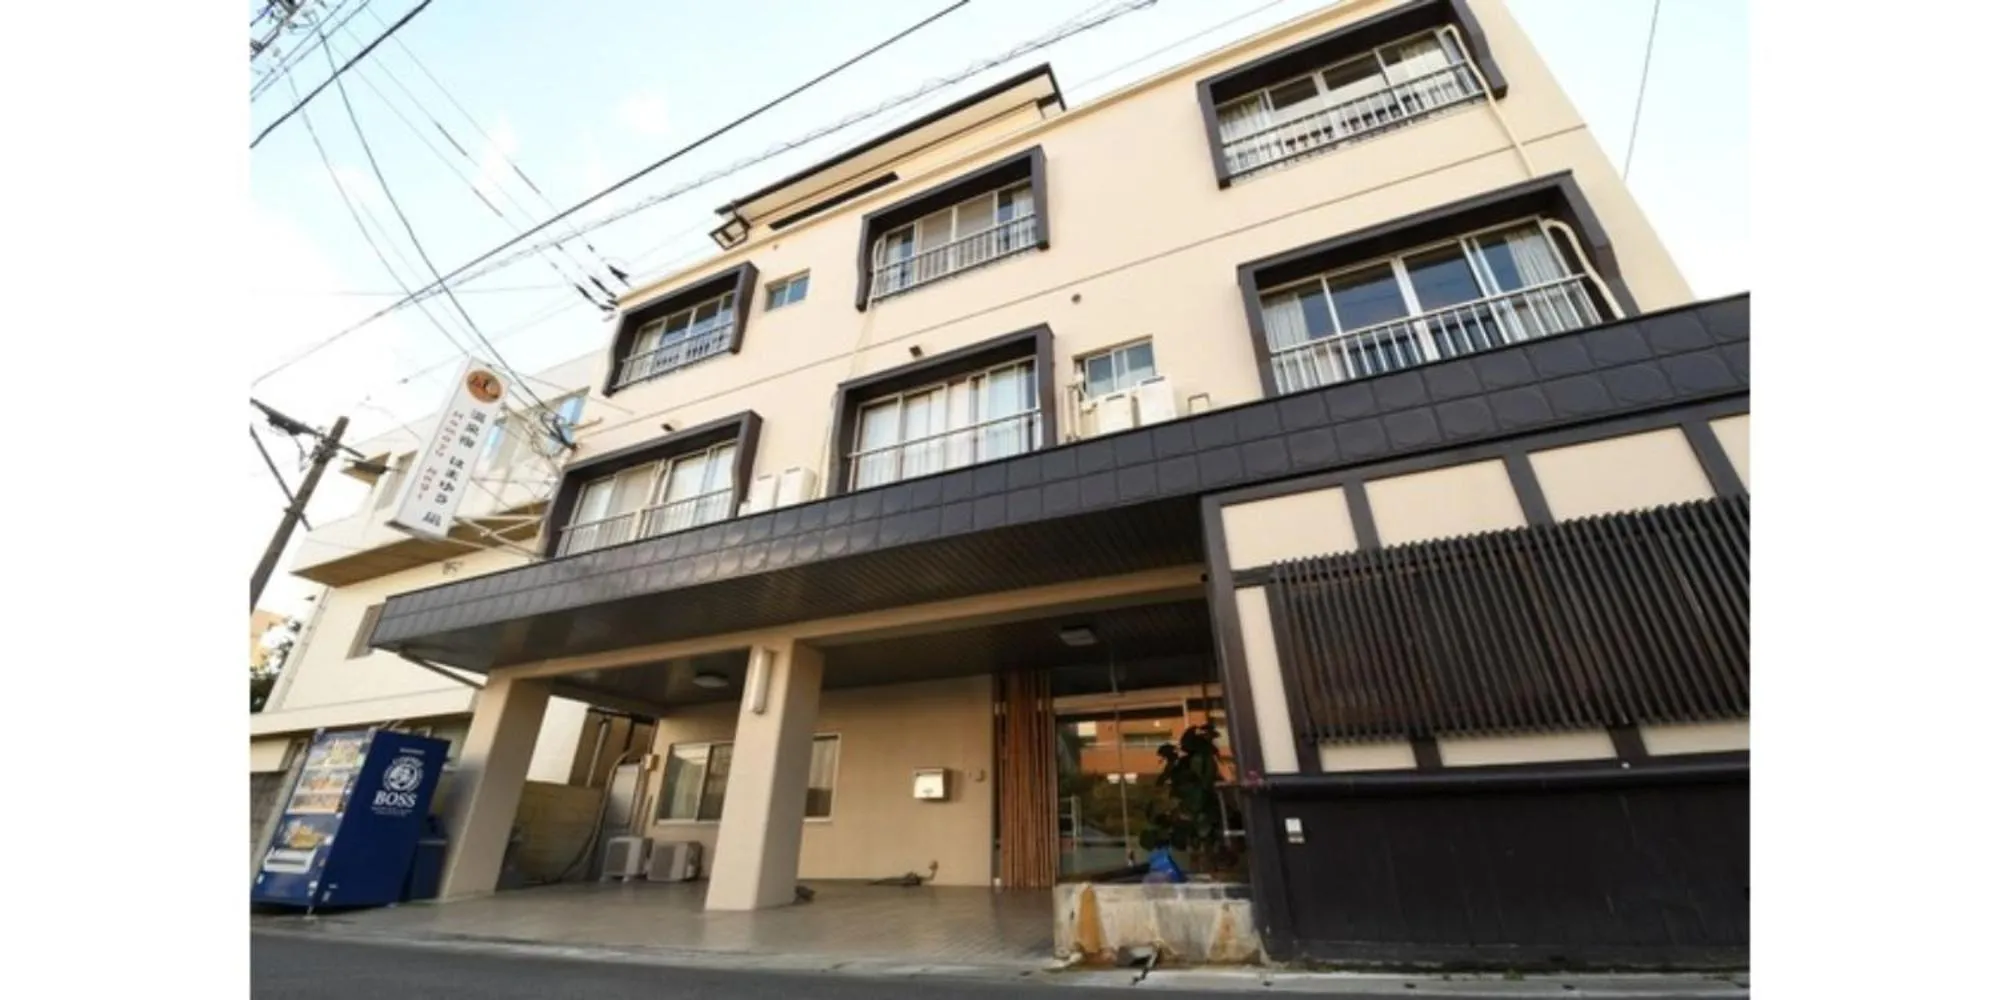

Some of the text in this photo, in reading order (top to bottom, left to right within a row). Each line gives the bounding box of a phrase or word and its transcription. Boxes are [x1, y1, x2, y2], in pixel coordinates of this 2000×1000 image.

[435, 456, 465, 505] はまゆう
[372, 790, 417, 808] BOSS
